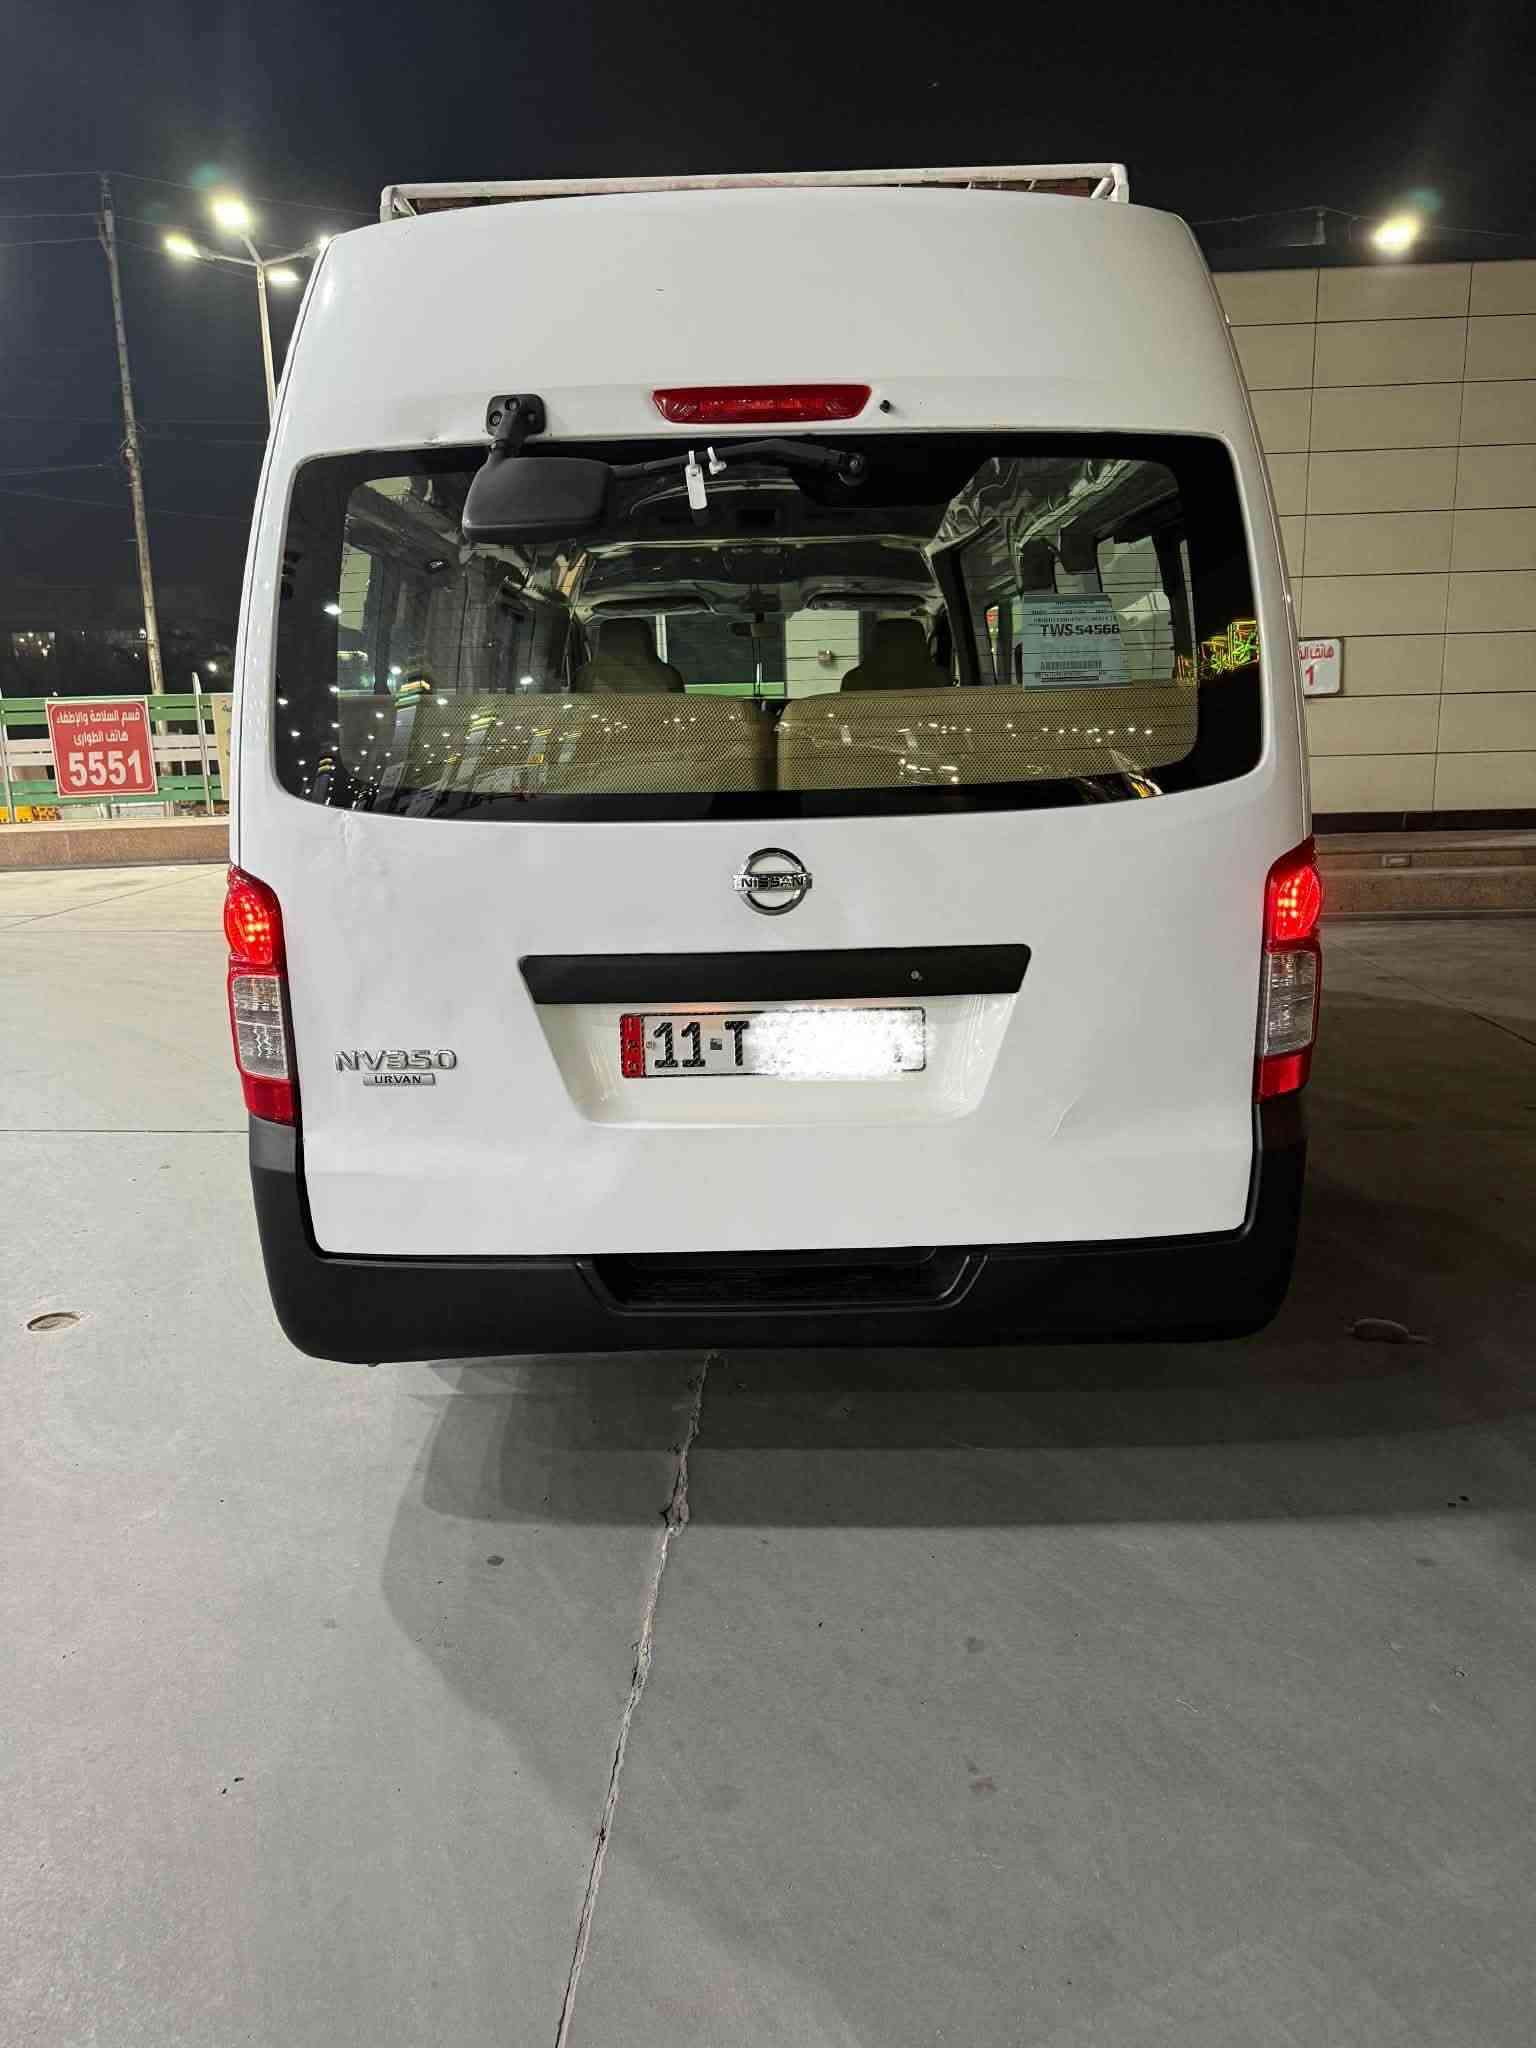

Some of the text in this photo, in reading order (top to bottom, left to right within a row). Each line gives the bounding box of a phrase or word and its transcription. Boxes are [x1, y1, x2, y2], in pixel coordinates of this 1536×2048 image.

[89, 710, 119, 722] السلامة
[121, 708, 140, 728] قسم
[105, 729, 129, 743] هاتف
[68, 749, 144, 787] 5551
[741, 876, 804, 888] NISSAN
[335, 1050, 457, 1072] NV350
[374, 1075, 421, 1084] URVAN
